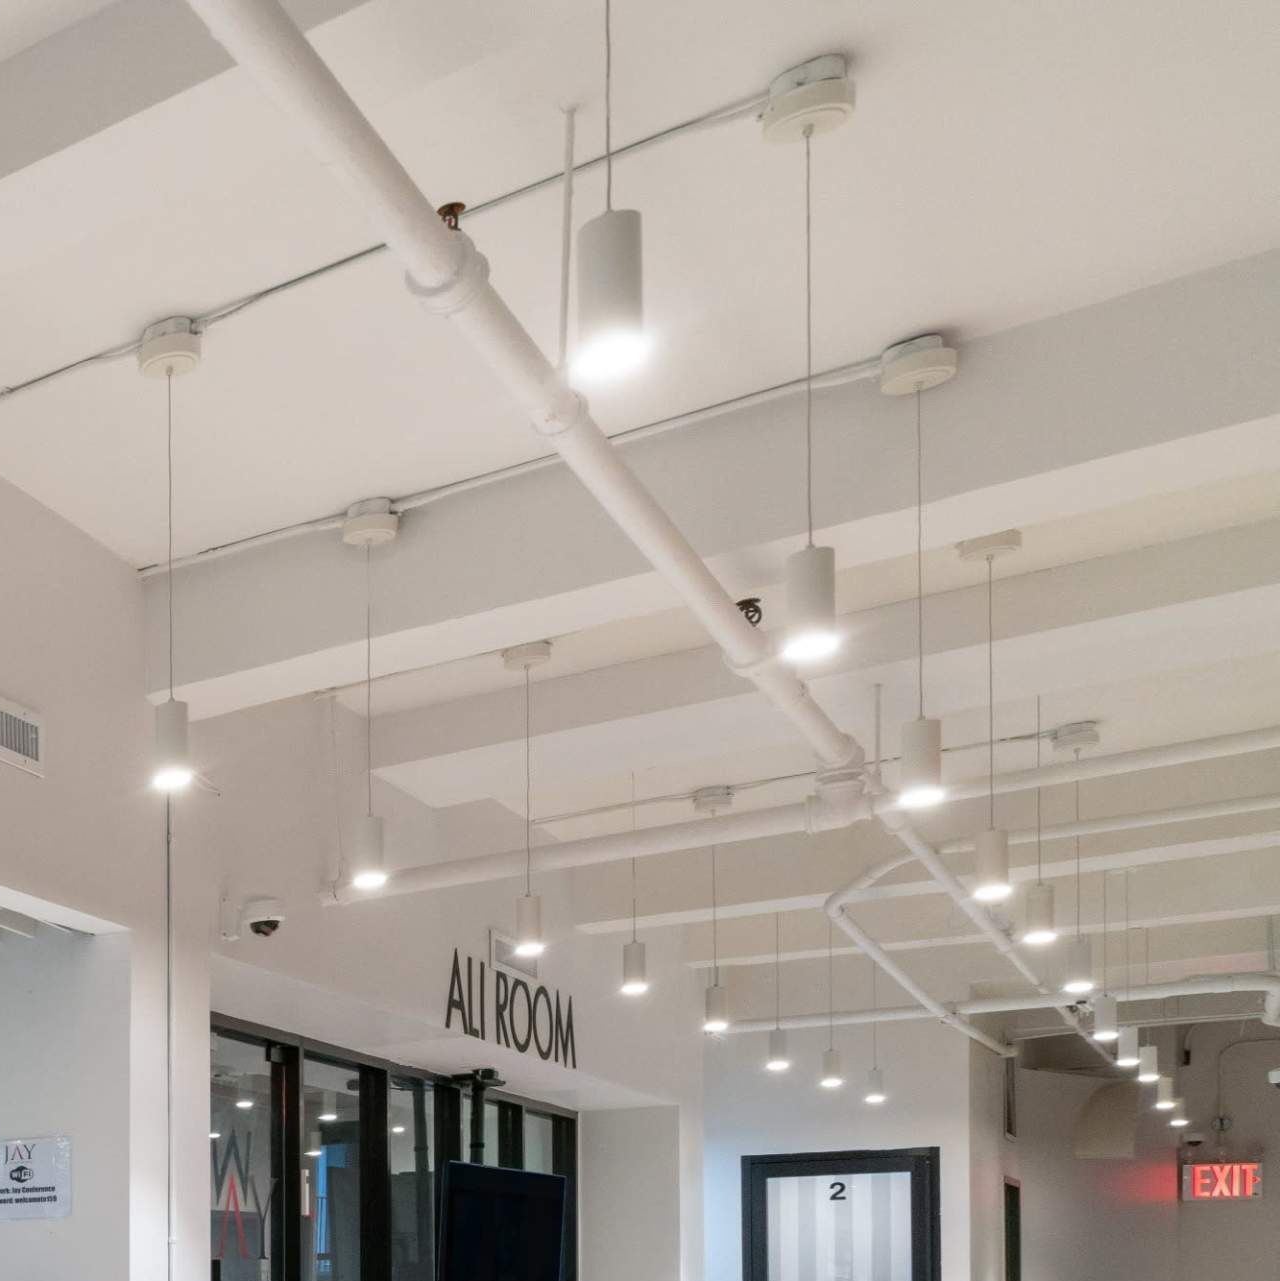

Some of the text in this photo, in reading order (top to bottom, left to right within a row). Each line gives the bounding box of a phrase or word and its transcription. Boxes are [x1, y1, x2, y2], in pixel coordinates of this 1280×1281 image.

[445, 947, 576, 1069] ALI ROOM
[5, 1144, 36, 1164] JAY
[830, 1181, 847, 1200] 2
[1192, 1163, 1258, 1197] EXIT
